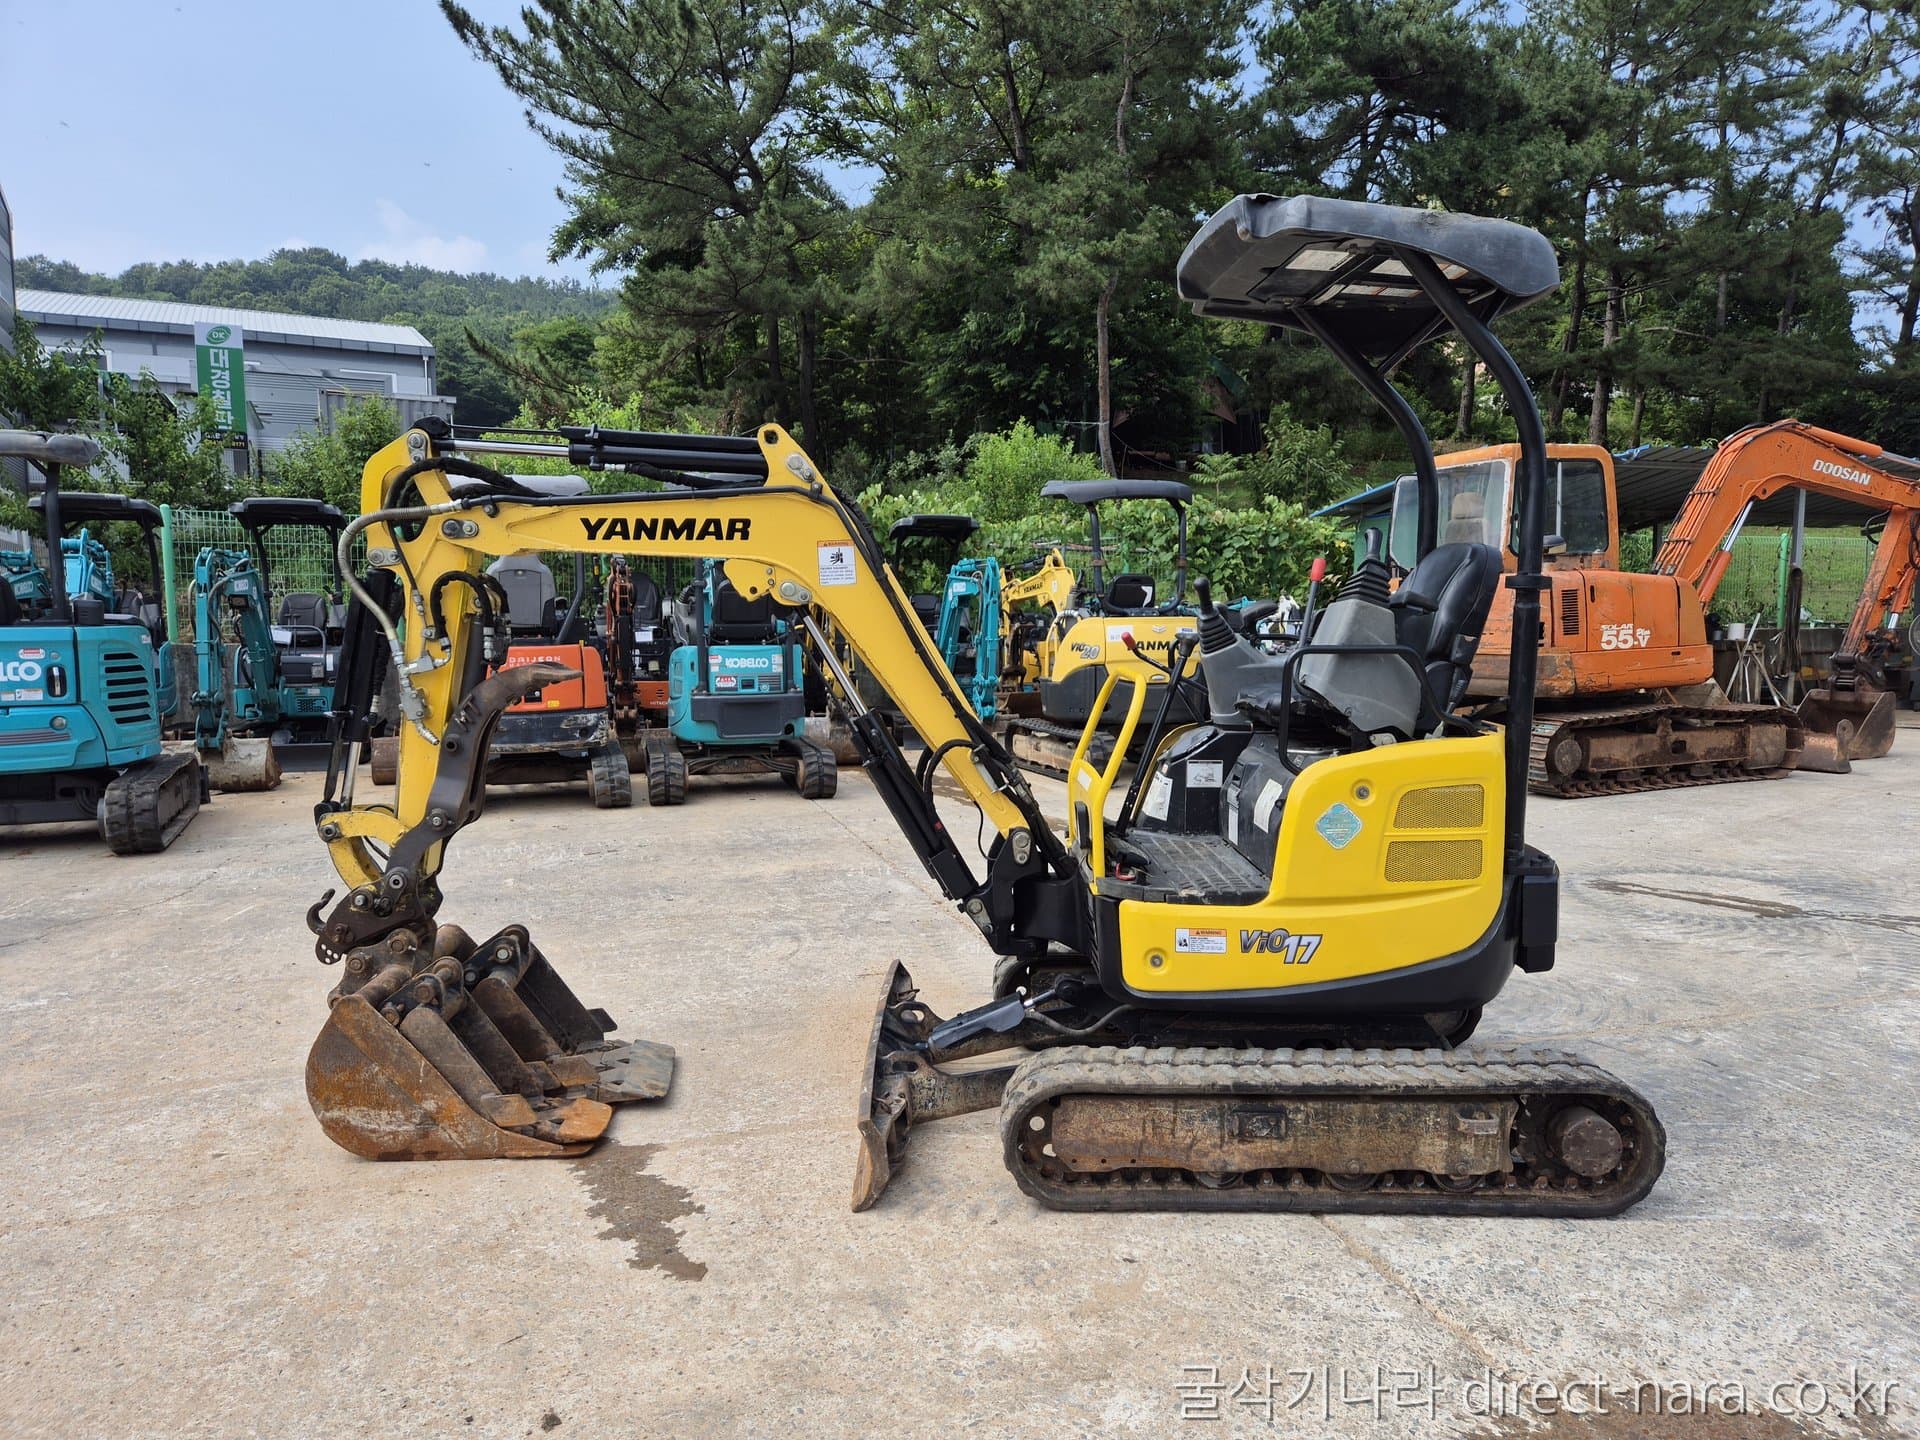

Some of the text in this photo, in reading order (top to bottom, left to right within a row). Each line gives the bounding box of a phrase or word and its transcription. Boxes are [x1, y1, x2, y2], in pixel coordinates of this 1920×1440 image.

[1812, 459, 1872, 486] DOOSAN
[579, 517, 751, 541] YANMAR
[1600, 623, 1634, 631] SOLAR
[725, 657, 769, 668] KOBELCO
